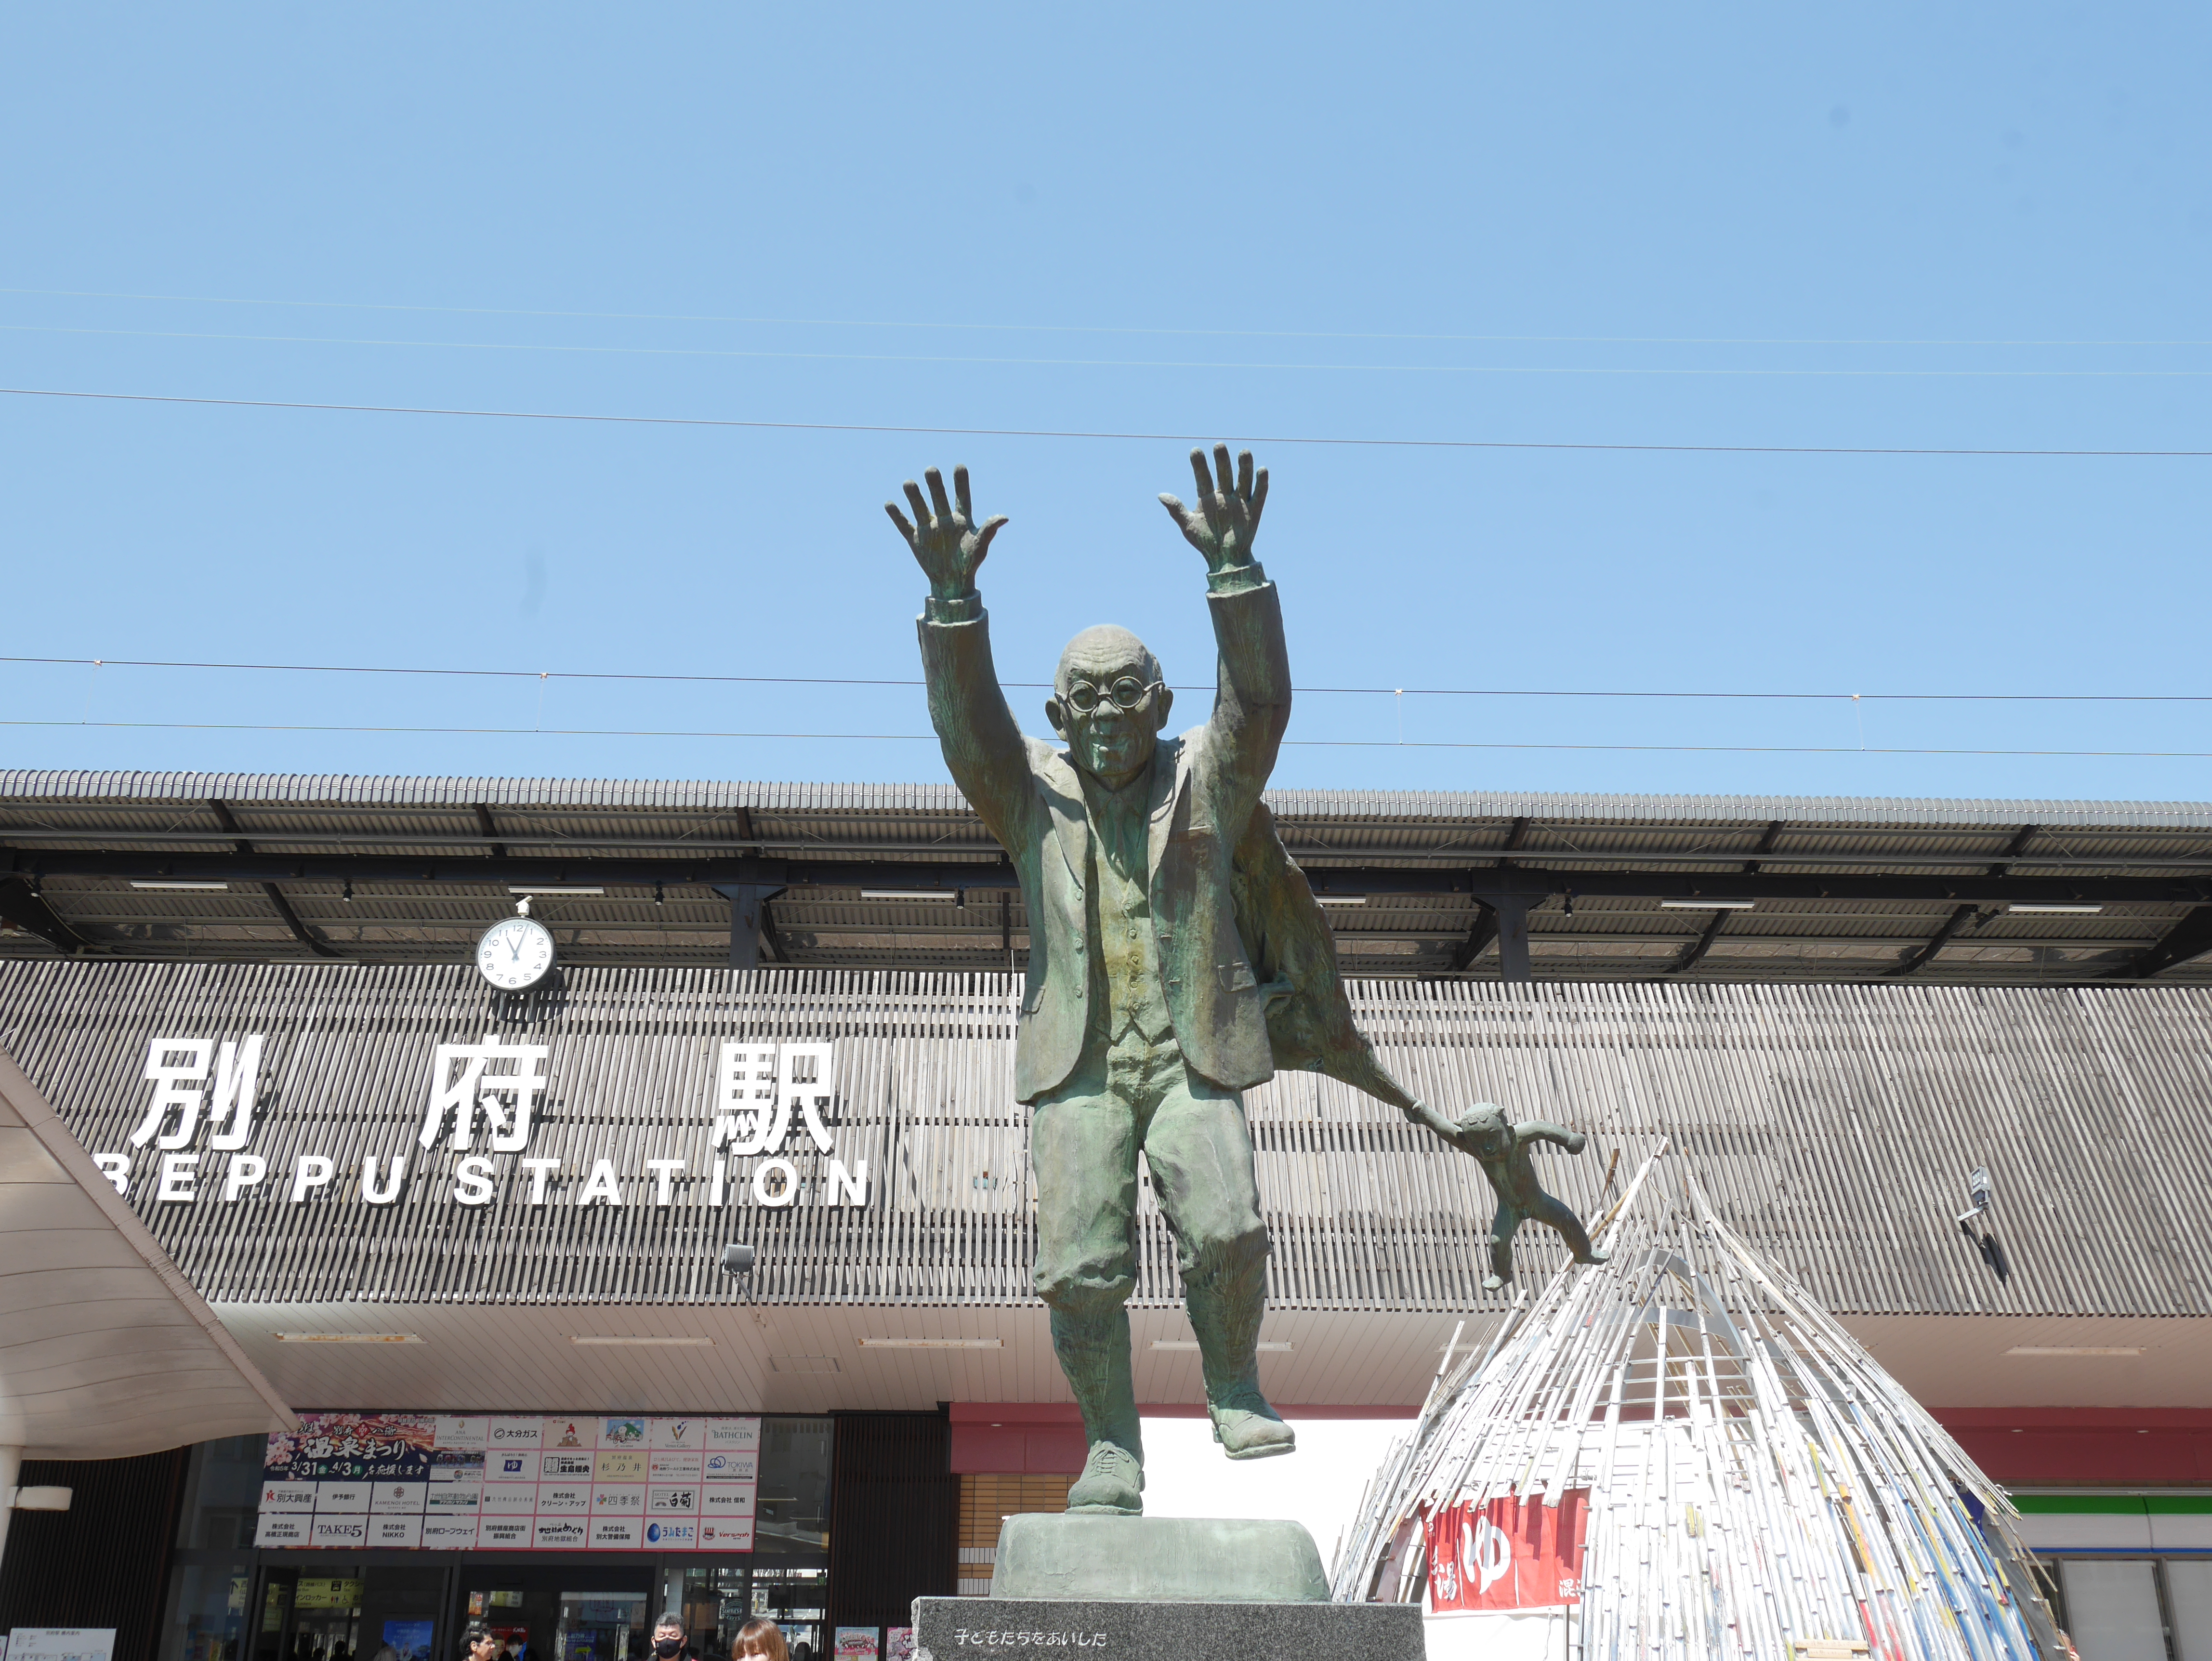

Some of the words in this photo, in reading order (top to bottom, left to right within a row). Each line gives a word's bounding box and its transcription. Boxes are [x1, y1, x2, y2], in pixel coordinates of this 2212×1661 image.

[131, 1035, 834, 1156] 別府駅
[93, 1153, 404, 1203] BEPPU
[454, 1156, 868, 1206] STATION
[333, 1425, 353, 1435] 別府
[711, 1430, 752, 1439] BATHCLIN
[303, 1436, 406, 1461] 温泉まつり
[291, 1462, 317, 1476] 3/31
[368, 1464, 424, 1476] を応援します
[602, 1463, 641, 1471] 杉乃井
[277, 1494, 312, 1503] 別大興産
[608, 1495, 640, 1505] 四季祭
[670, 1491, 692, 1508] 白菊
[662, 1527, 694, 1537] うみたまご
[1462, 1516, 1511, 1595] ゆ
[954, 1629, 1106, 1646] 子どもたちをあいした
